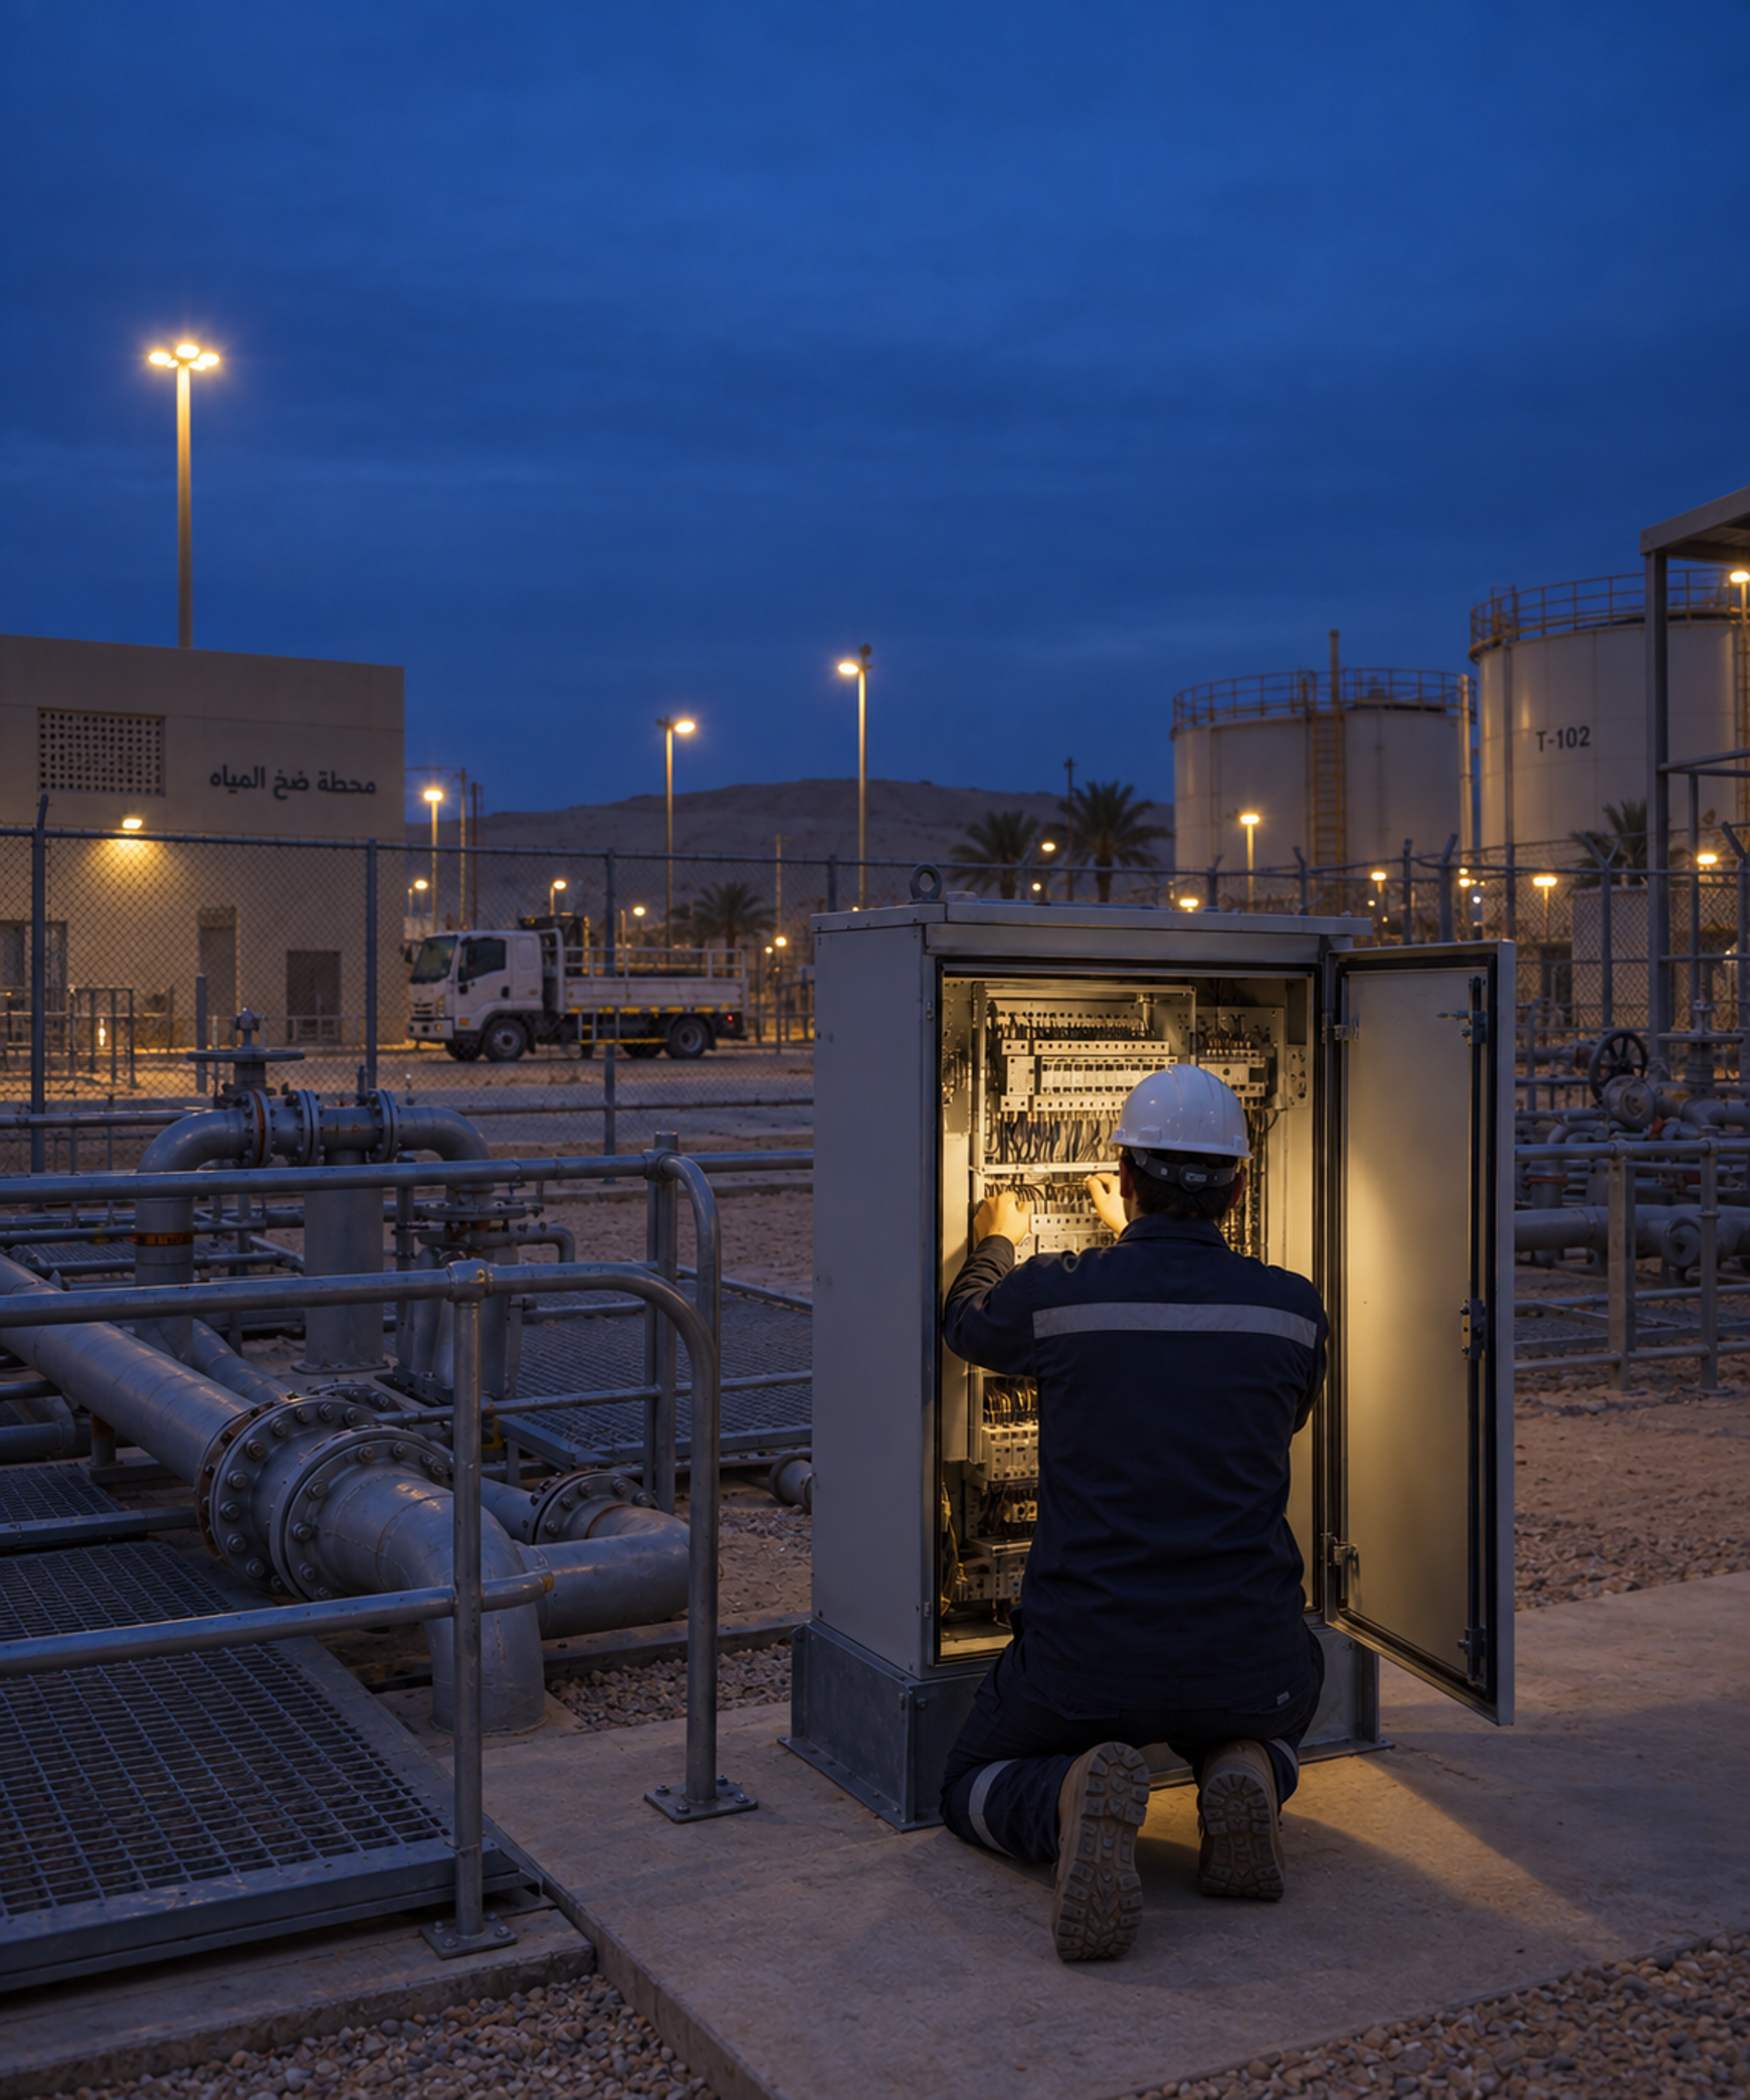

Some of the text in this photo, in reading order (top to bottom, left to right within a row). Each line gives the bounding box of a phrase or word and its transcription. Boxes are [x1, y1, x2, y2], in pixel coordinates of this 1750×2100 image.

[1536, 726, 1590, 751] T-102
[210, 764, 376, 800] محطة ضخ المياه
